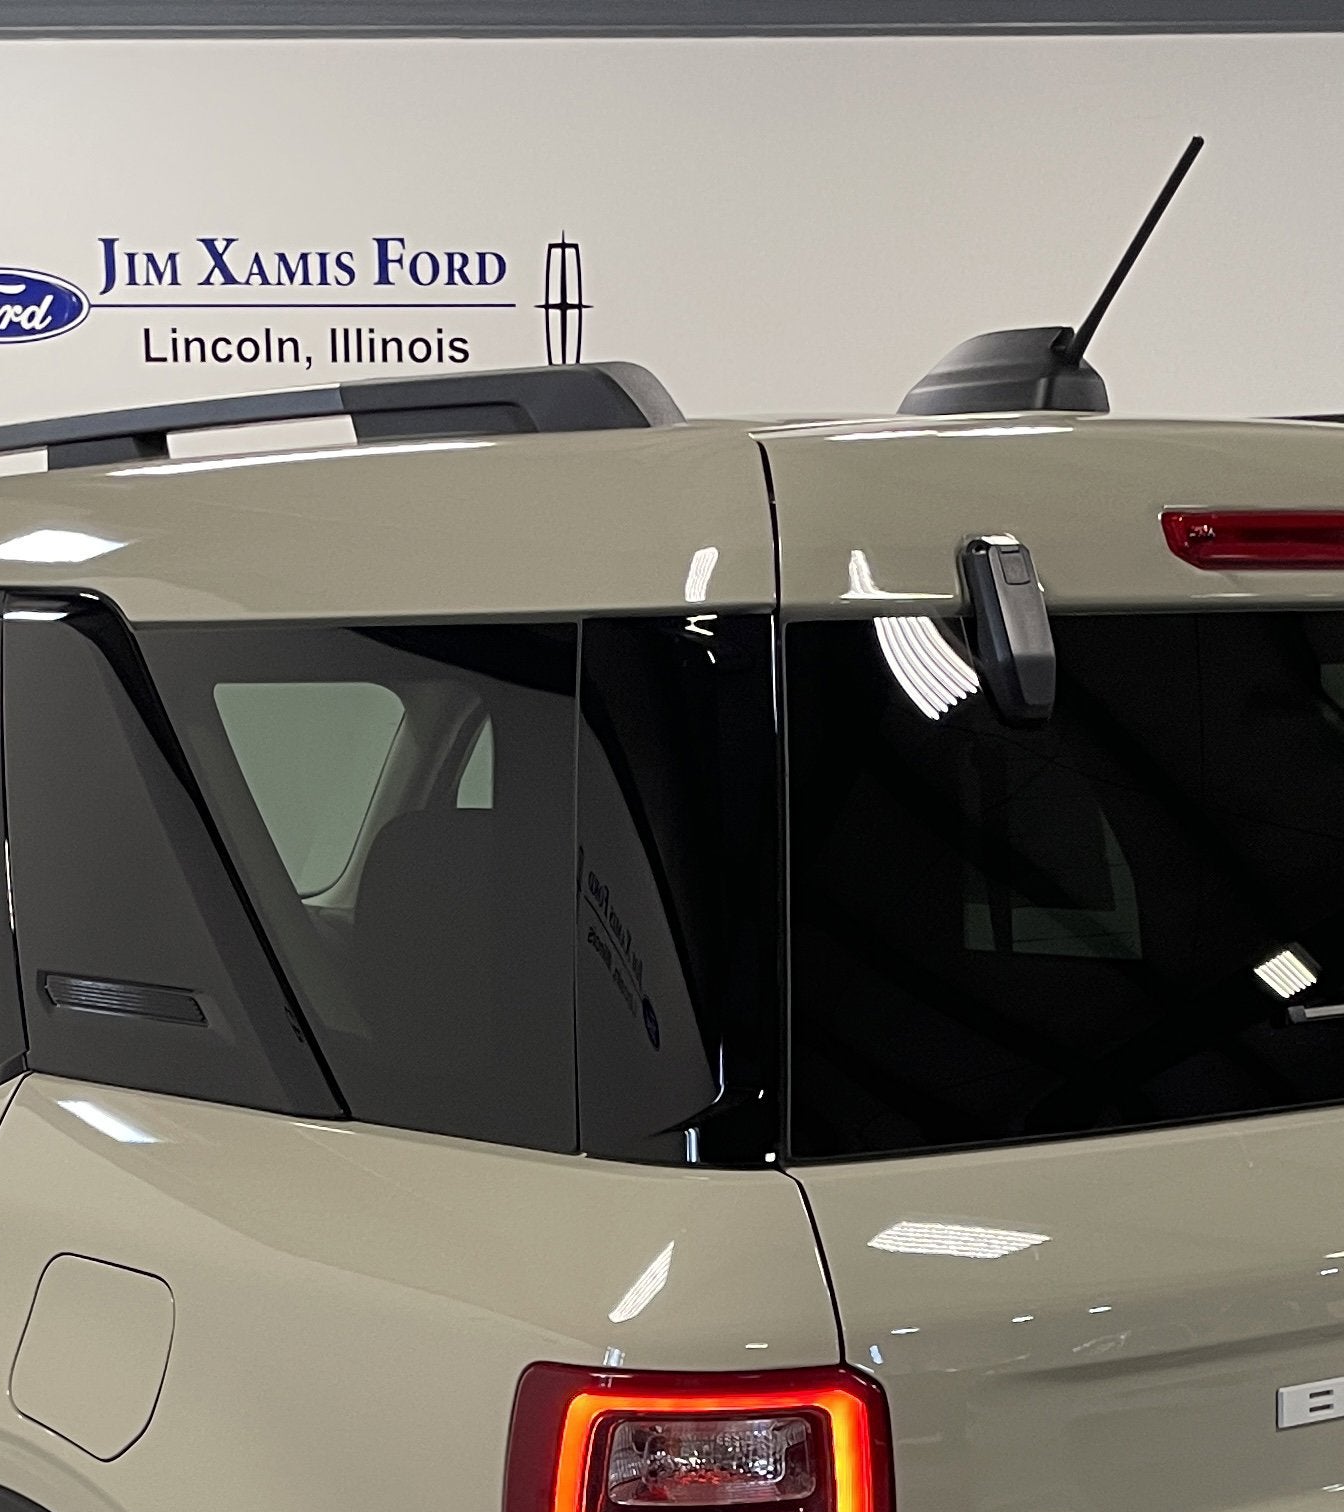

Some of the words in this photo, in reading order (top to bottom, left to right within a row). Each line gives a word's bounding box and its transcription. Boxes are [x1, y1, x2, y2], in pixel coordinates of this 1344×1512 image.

[97, 237, 183, 295] JIM
[197, 237, 356, 287] XAMIS
[372, 236, 507, 287] FORD
[143, 328, 313, 370] Lincoln,
[329, 328, 470, 365] Illinois
